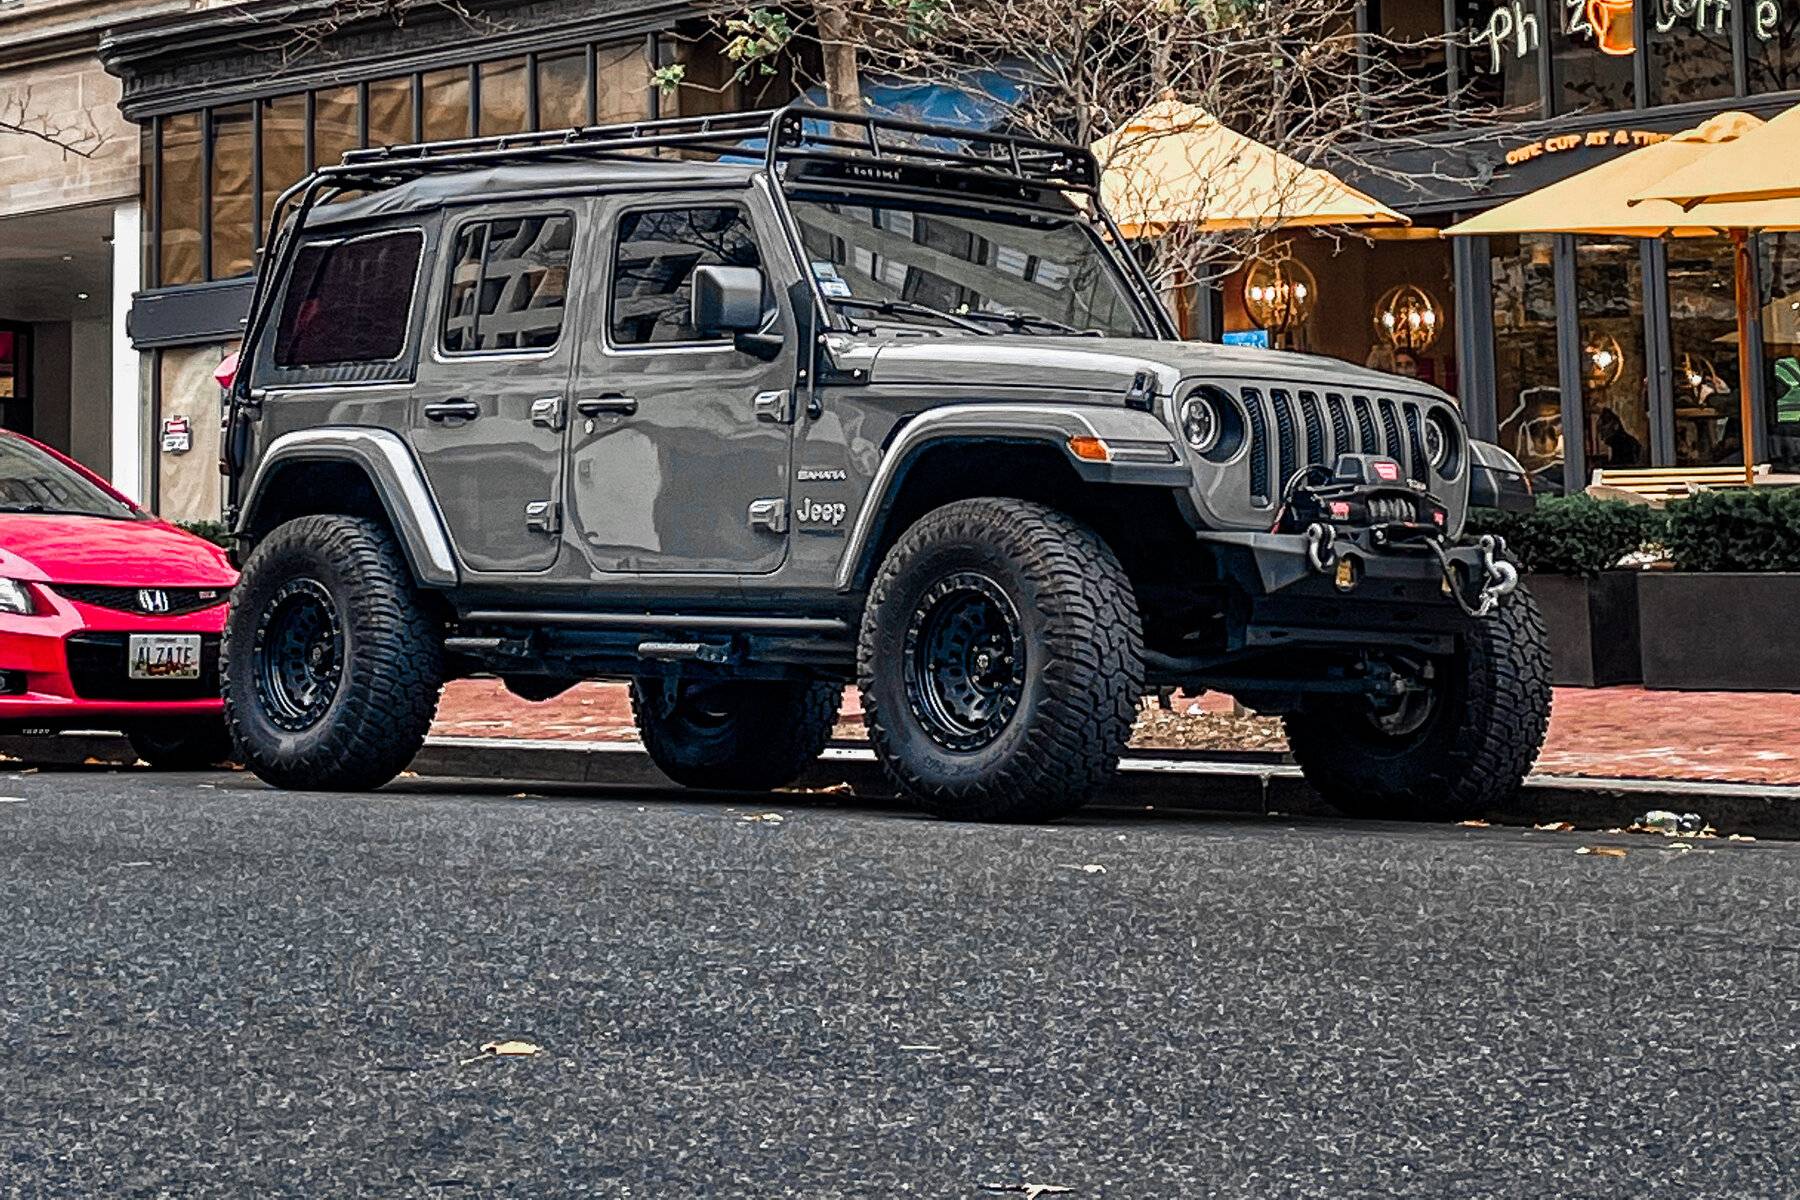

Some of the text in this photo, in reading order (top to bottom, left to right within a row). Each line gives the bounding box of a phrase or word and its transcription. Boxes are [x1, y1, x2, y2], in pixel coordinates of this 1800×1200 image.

[1505, 142, 1543, 165] ONE
[1545, 134, 1582, 152] CUP
[1585, 130, 1610, 147] AT
[1613, 129, 1629, 145] A
[796, 497, 847, 526] Jeep
